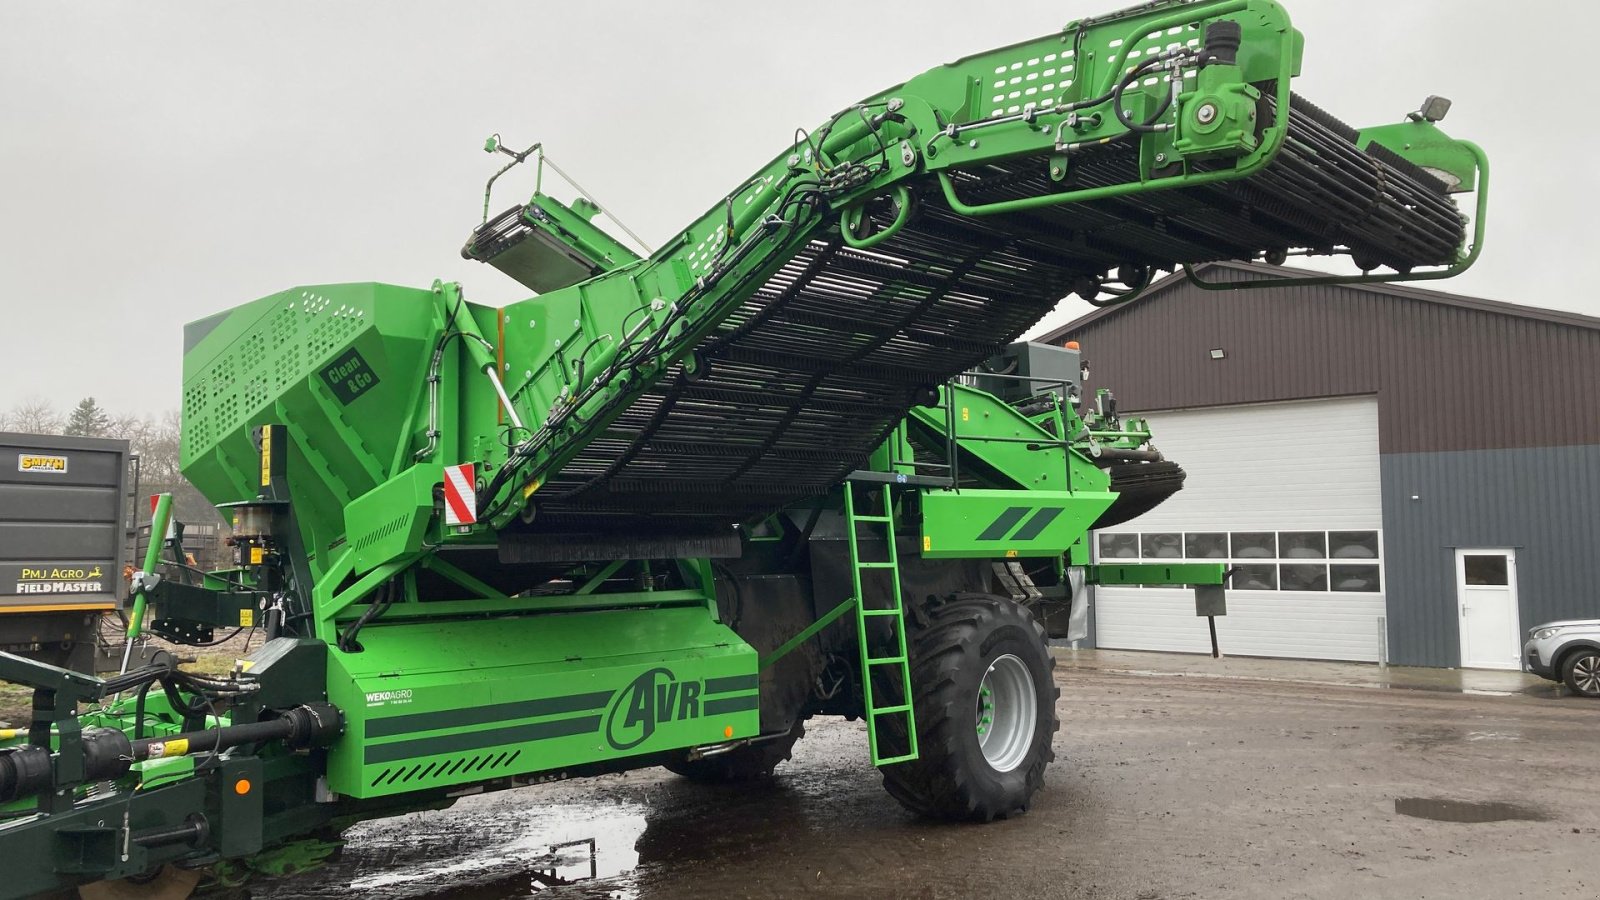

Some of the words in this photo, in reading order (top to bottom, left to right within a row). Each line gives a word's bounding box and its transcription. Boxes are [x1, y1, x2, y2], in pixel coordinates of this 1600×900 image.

[328, 357, 361, 384] Clean
[22, 457, 65, 470] SMYTH
[22, 569, 47, 579] PMJ
[51, 568, 84, 579] AGRO
[606, 667, 702, 750] AVR
